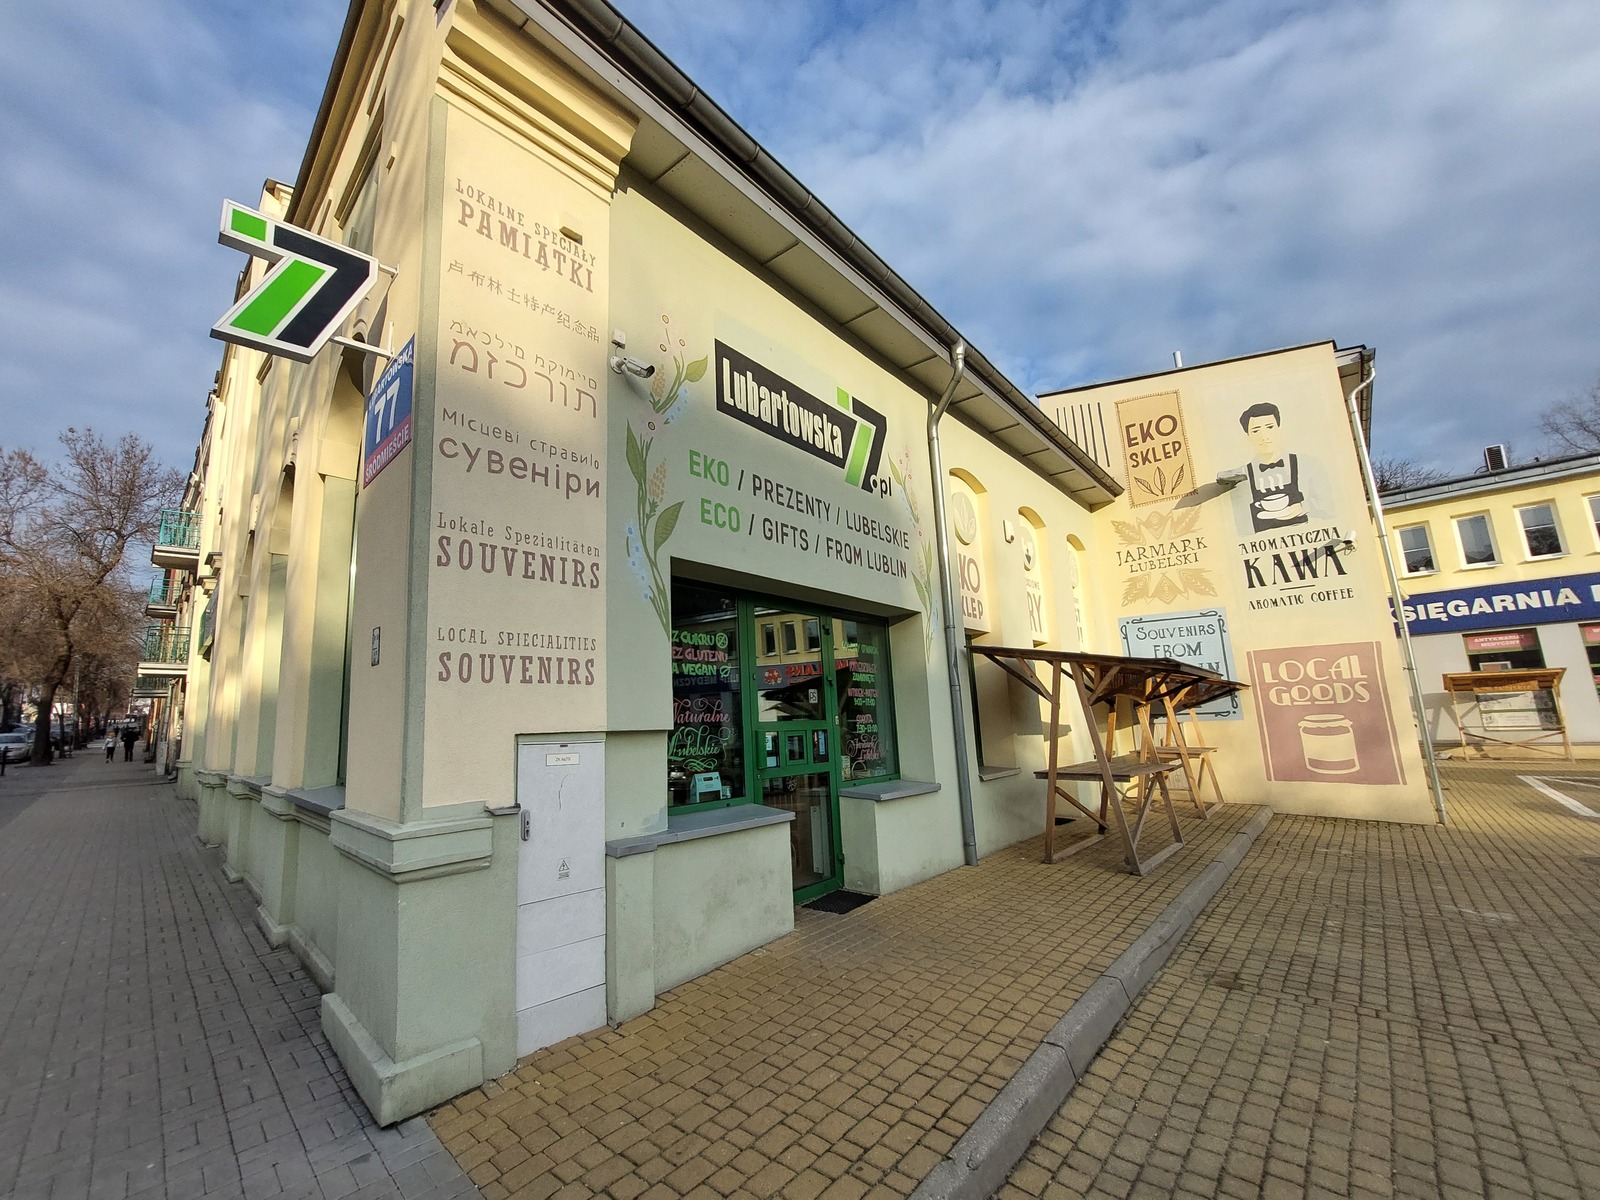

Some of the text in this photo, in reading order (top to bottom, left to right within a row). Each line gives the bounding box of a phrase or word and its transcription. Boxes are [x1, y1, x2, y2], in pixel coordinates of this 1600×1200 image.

[455, 178, 596, 267] LOKALNE SPECJAŁY
[458, 198, 594, 293] PAMIĄTKI
[374, 377, 400, 445] 77
[722, 357, 844, 459] Lubartowska
[1125, 414, 1178, 448] EKO
[365, 423, 409, 482] ŚRÓDMIEŚCIE
[438, 437, 600, 499] сувеніри
[1129, 440, 1182, 469] SKLEP
[689, 449, 729, 487] EKO
[752, 473, 832, 522] PREZENTY
[846, 509, 910, 550] LUBELSKIE
[437, 511, 600, 558] Lokale Spezialitäten
[700, 497, 741, 533] ECO
[762, 517, 809, 551] GIFTS
[826, 537, 863, 567] FROM
[867, 552, 908, 579] LUBLIN
[1238, 527, 1341, 555] AROMATYCZNA
[436, 535, 600, 589] SOUVENIRS
[1116, 537, 1208, 567] JARMARK
[1130, 552, 1200, 573] LUBELSKI
[1243, 545, 1348, 589] KAWA
[958, 553, 980, 594] KO
[1026, 591, 1043, 634] RY
[1248, 588, 1354, 611] AROMATIC COFFEE
[437, 627, 597, 651] LOCAL SPIECIALITIES
[680, 631, 715, 646] CUKRU
[1136, 623, 1216, 641] SOUVENIRS
[684, 648, 728, 663] GLUTENU
[1153, 641, 1204, 659] FROM
[438, 651, 595, 686] SOUVENIRS
[682, 663, 717, 676] VEGAN
[1262, 655, 1368, 683] LOCAL
[673, 697, 730, 724] Naturalne
[1269, 681, 1370, 706] GOODS
[668, 725, 725, 761] Lubelskie
